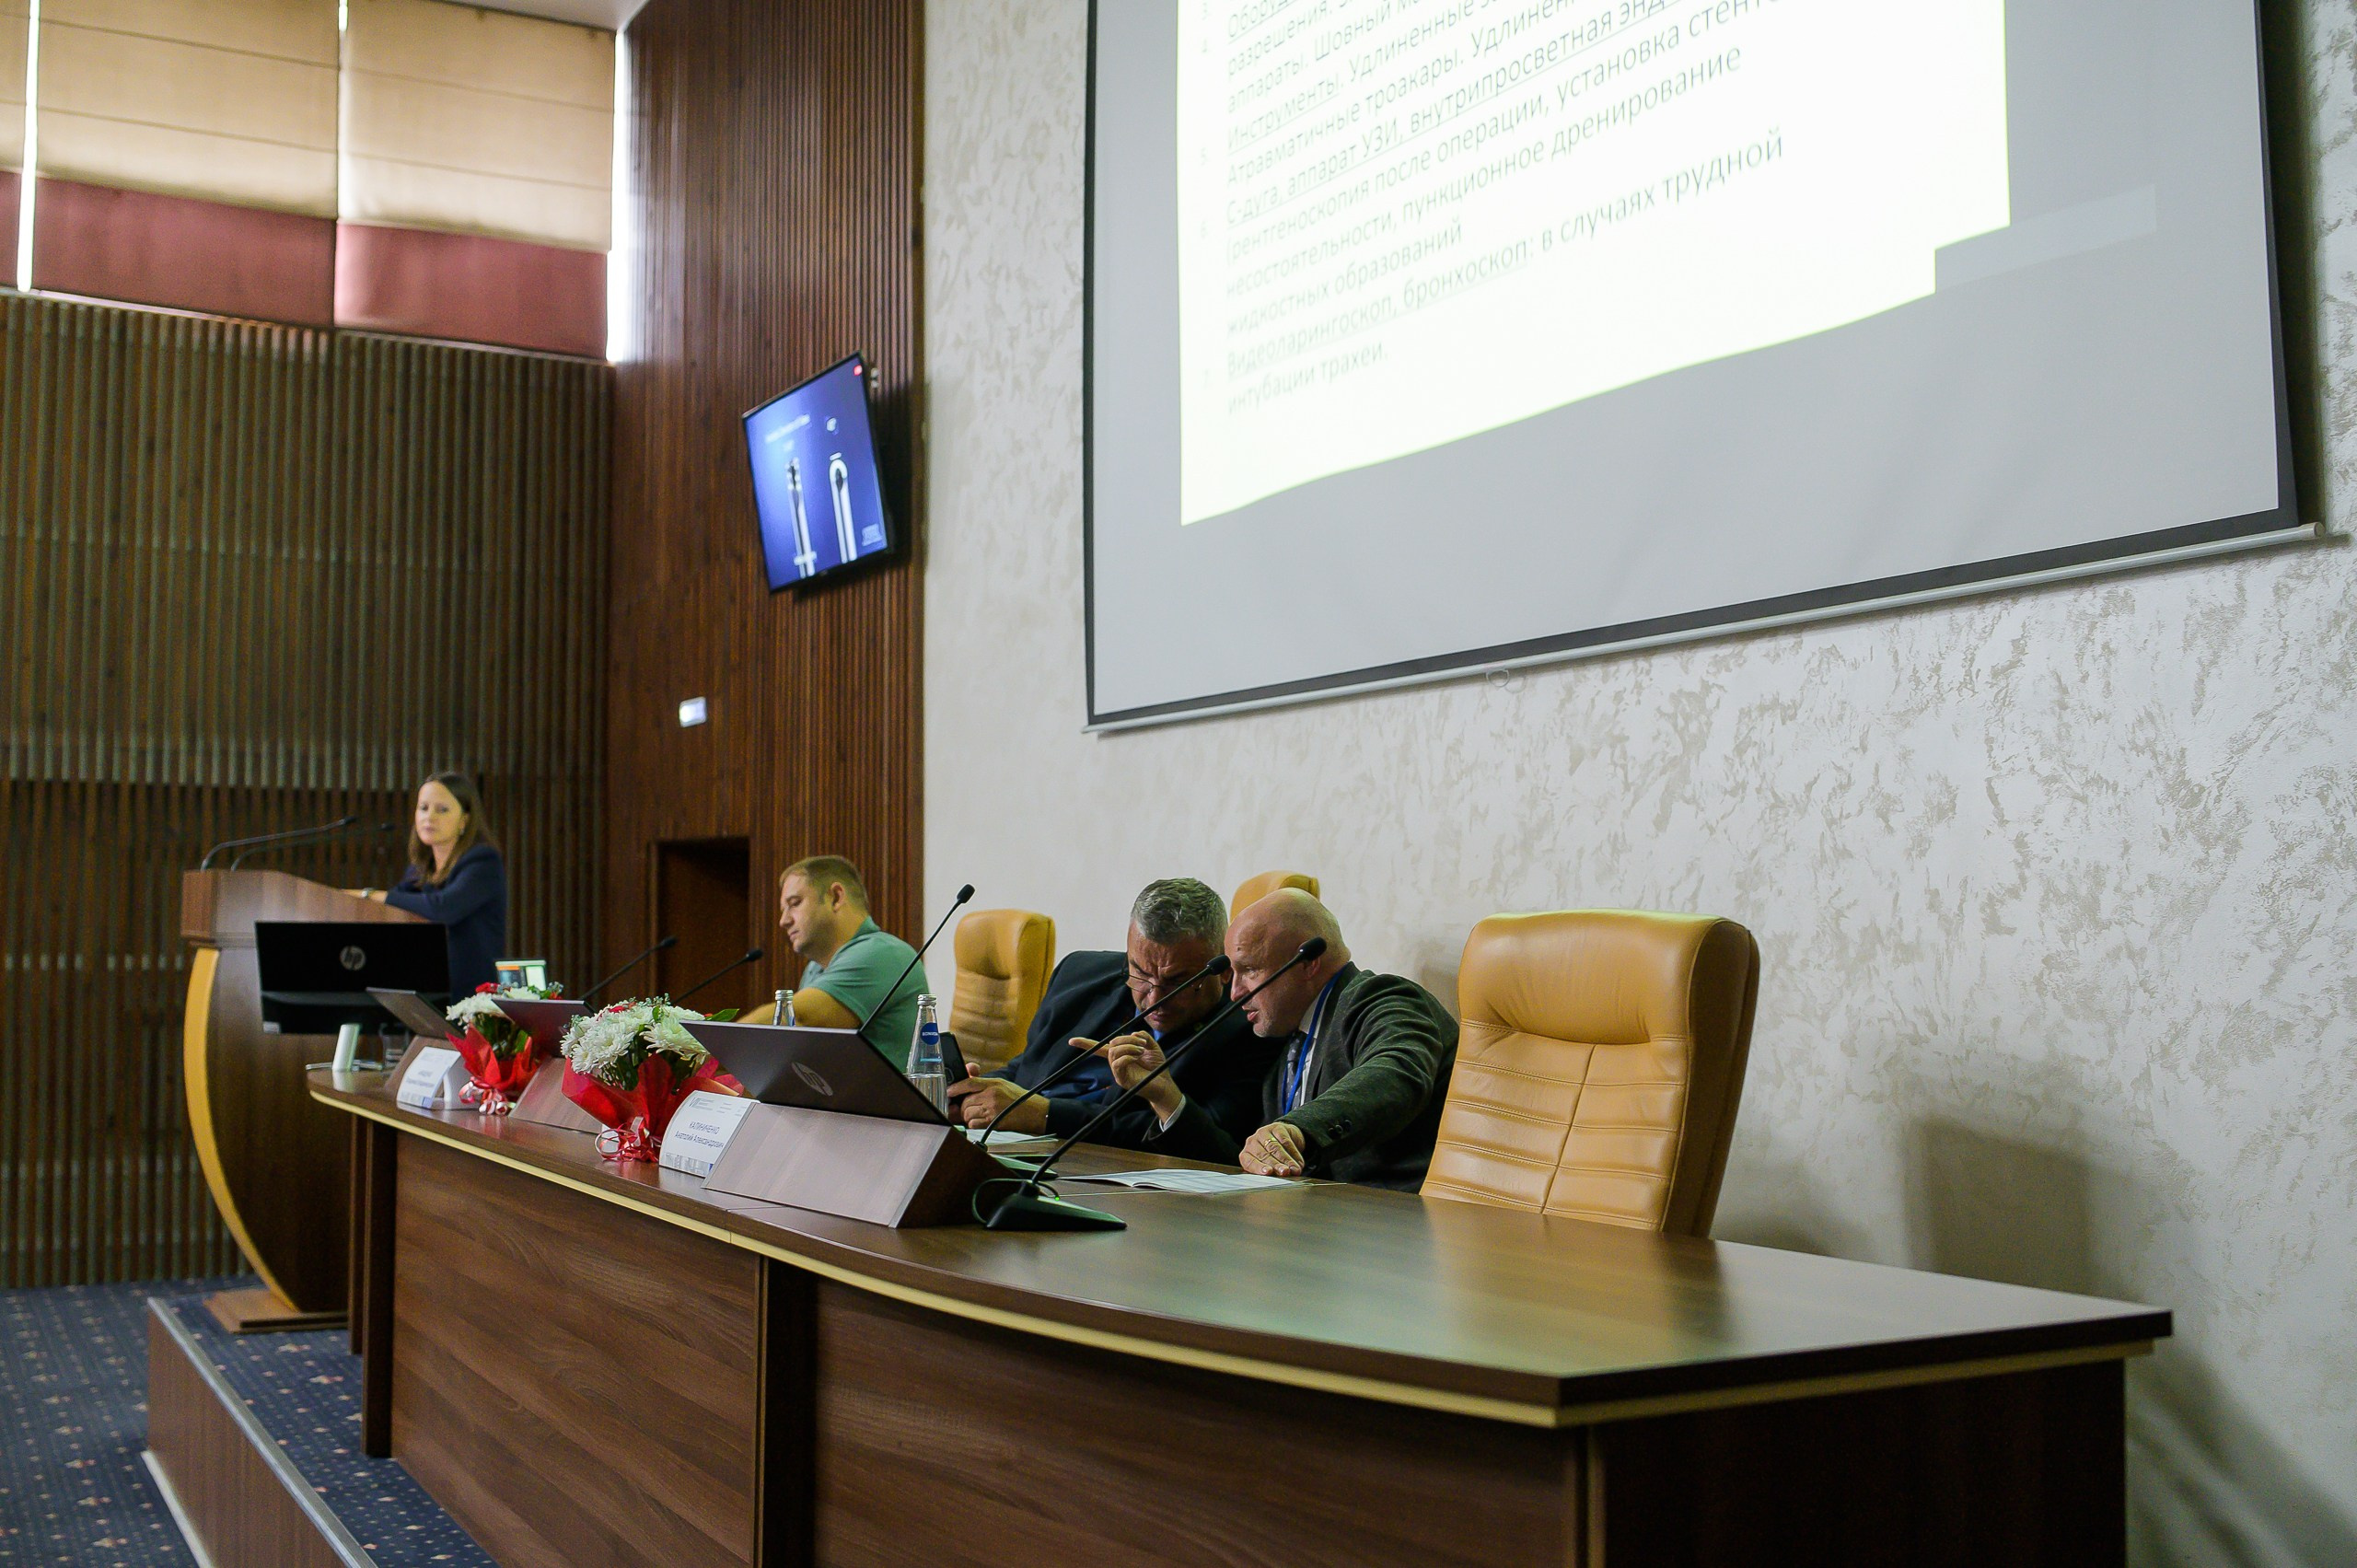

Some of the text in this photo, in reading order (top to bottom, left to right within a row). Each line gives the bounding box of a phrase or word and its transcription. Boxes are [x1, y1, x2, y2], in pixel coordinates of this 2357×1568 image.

[1227, 102, 1360, 185] Атравматичные
[1364, 48, 1464, 114] троакары.
[1227, 184, 1283, 226] С-дуга,
[1288, 145, 1356, 197] аппарат
[1362, 117, 1403, 157] УЗИ,
[1411, 11, 1612, 134] внутрипросветная
[1227, 180, 1368, 265] (рентгеноскопия
[1376, 150, 1431, 194] после
[1437, 94, 1550, 163] операции,
[1557, 25, 1680, 110] установка
[1228, 73, 1344, 150] Инструменты.
[1349, 0, 1474, 83] Удлиненные
[1228, 52, 1309, 114] аппараты.
[1227, 47, 1741, 299] несостоятельности, пункционное дренирование
[1403, 236, 1535, 309] бронхоскоп:
[1540, 227, 1553, 252] в
[1561, 185, 1655, 242] случаях
[1664, 125, 1782, 203] трудной
[1227, 215, 1462, 337] жидкостных образований
[1228, 366, 1315, 414] интубации
[343, 946, 364, 970] hp
